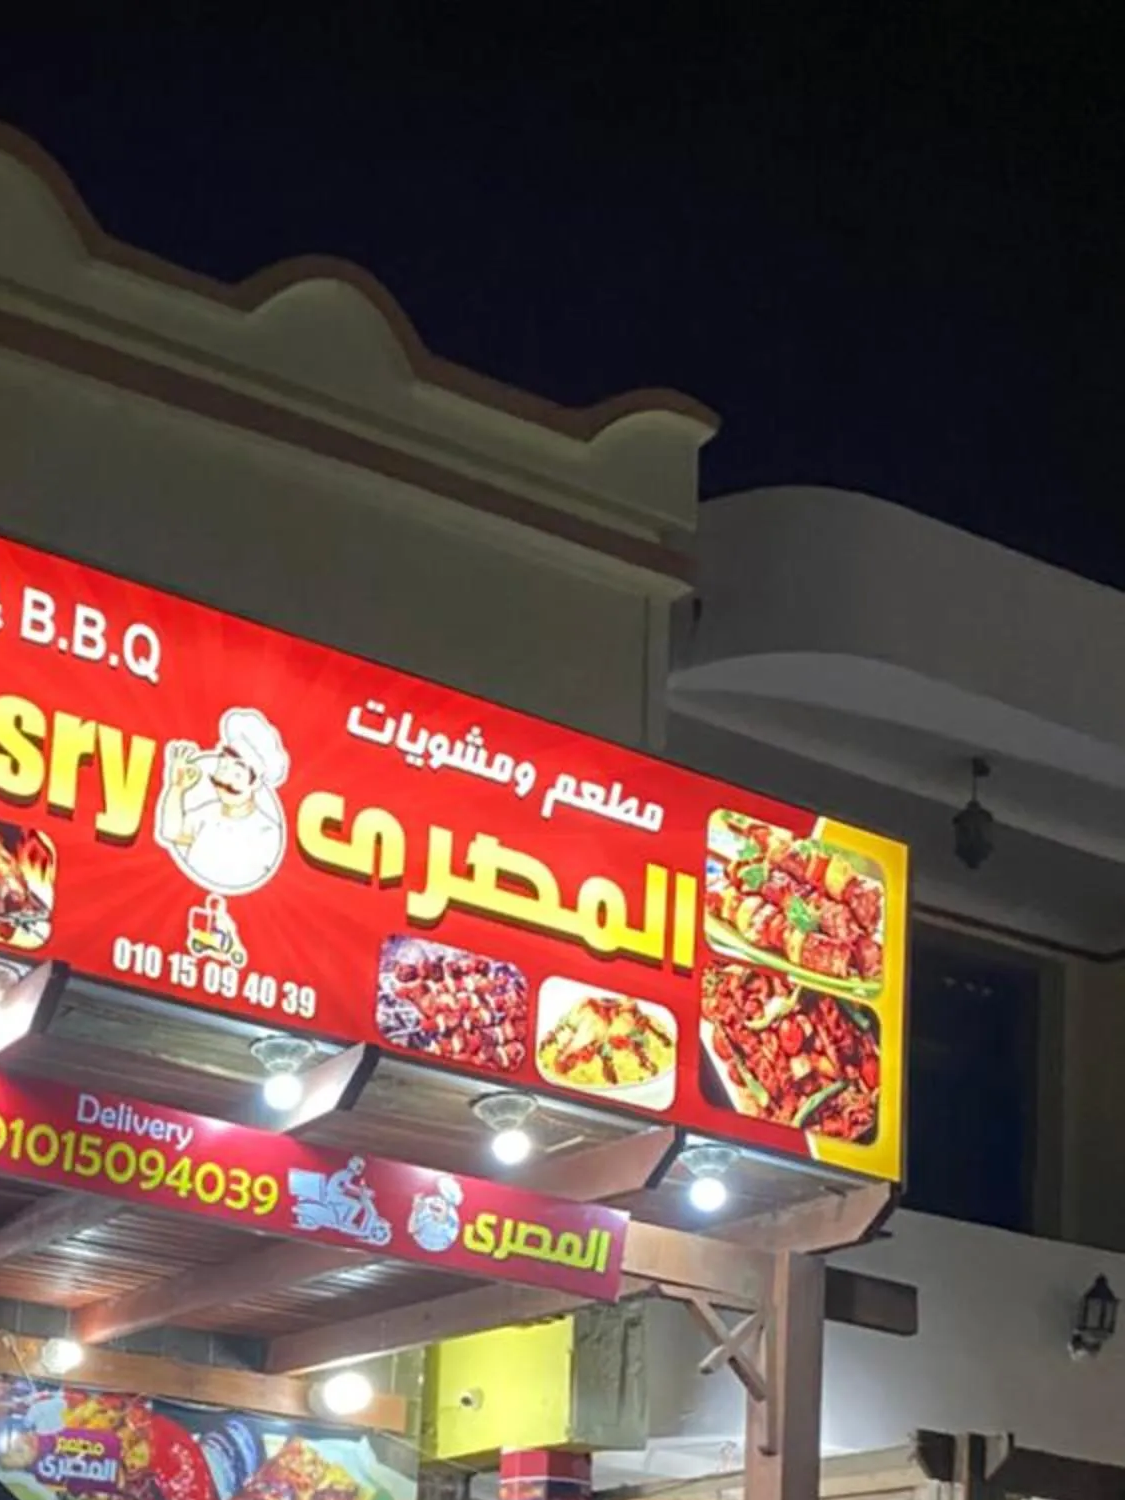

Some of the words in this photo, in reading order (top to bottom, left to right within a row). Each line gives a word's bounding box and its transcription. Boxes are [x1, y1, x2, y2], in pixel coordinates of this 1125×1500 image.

[20, 586, 162, 684] B.B.Q
[346, 699, 537, 798] ومشويات
[541, 772, 665, 832] مطعم
[112, 936, 163, 979] 010
[168, 952, 198, 988] 15
[202, 961, 239, 998] 09
[242, 972, 277, 1009] 40
[280, 981, 317, 1019] 39
[76, 1092, 195, 1151] Delivery
